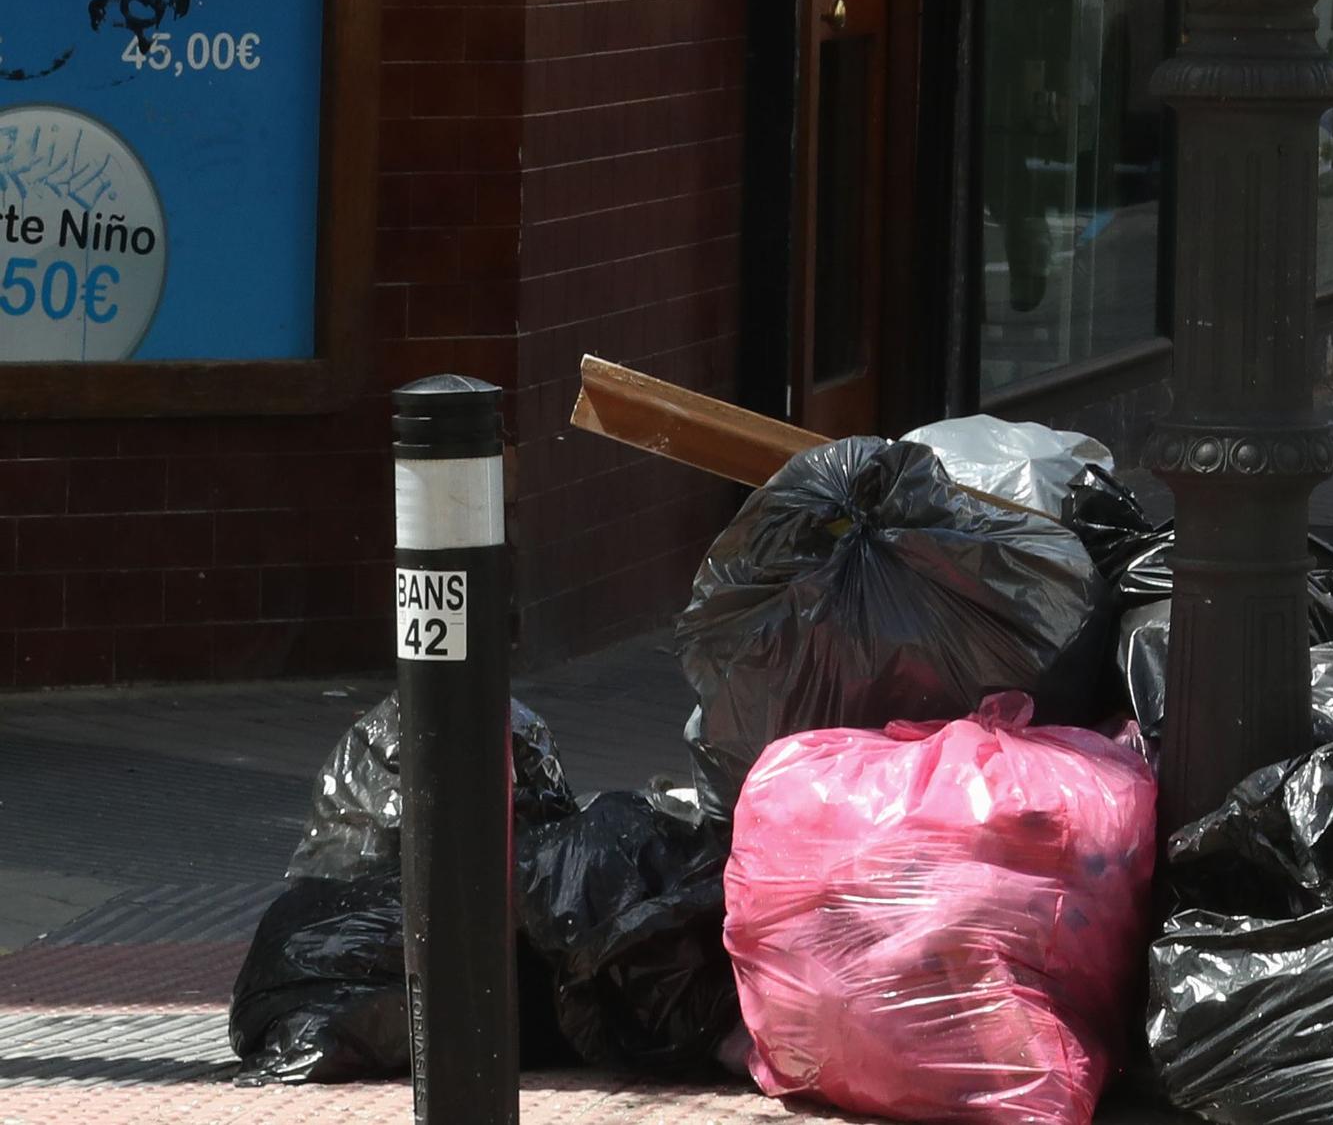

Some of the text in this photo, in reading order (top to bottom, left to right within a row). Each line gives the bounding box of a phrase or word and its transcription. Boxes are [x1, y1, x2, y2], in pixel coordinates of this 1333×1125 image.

[121, 32, 262, 78] 45,00€
[59, 208, 156, 256] Niño
[398, 573, 464, 611] BANS
[404, 617, 449, 656] 42
